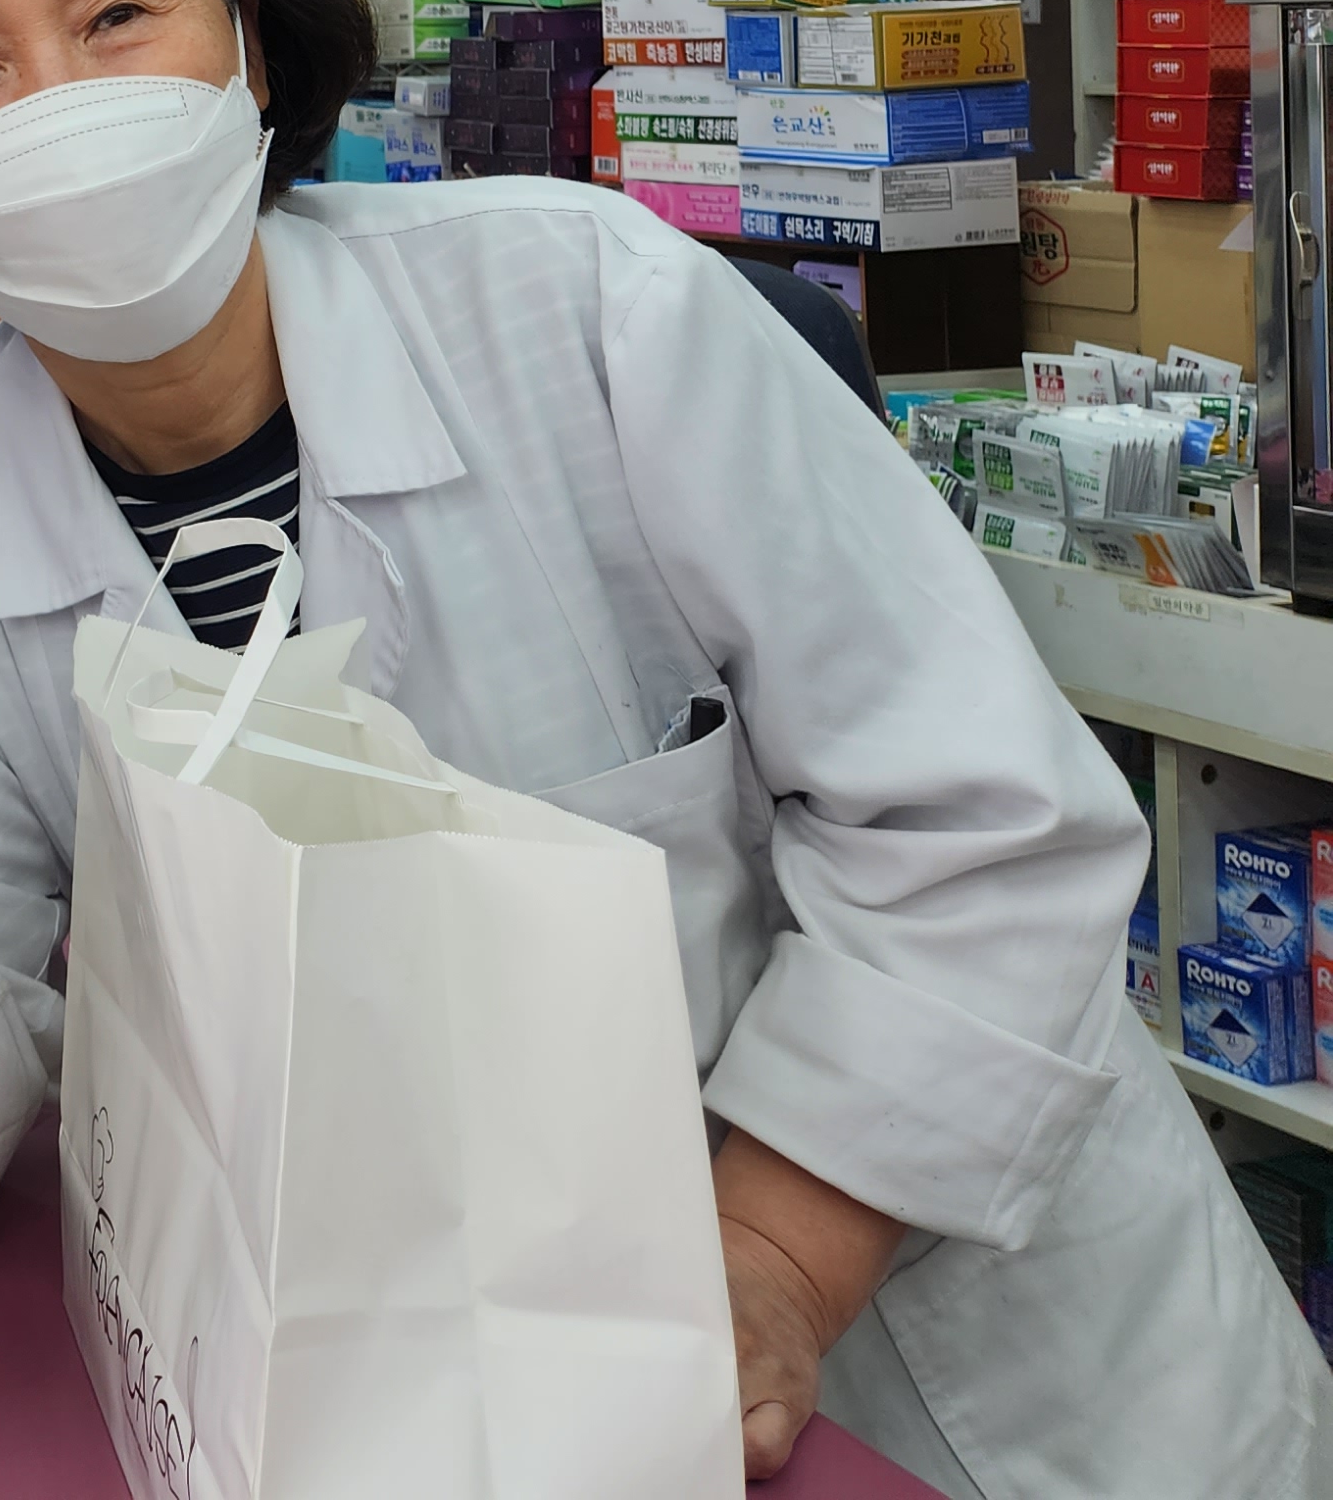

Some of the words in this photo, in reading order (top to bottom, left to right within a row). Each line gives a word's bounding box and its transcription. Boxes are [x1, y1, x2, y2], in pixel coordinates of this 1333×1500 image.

[607, 42, 637, 64] 코막힘
[645, 42, 677, 63] 축농증
[685, 41, 723, 64] 만성비염
[616, 118, 649, 137] 소화불량
[653, 118, 694, 139] 속쓰림/숙취
[772, 115, 824, 136] 은교산
[785, 219, 824, 240] 쉰목소리
[833, 221, 874, 246] 구역/기침
[1225, 844, 1290, 878] ROHTO
[1187, 959, 1251, 996] ROHTO
